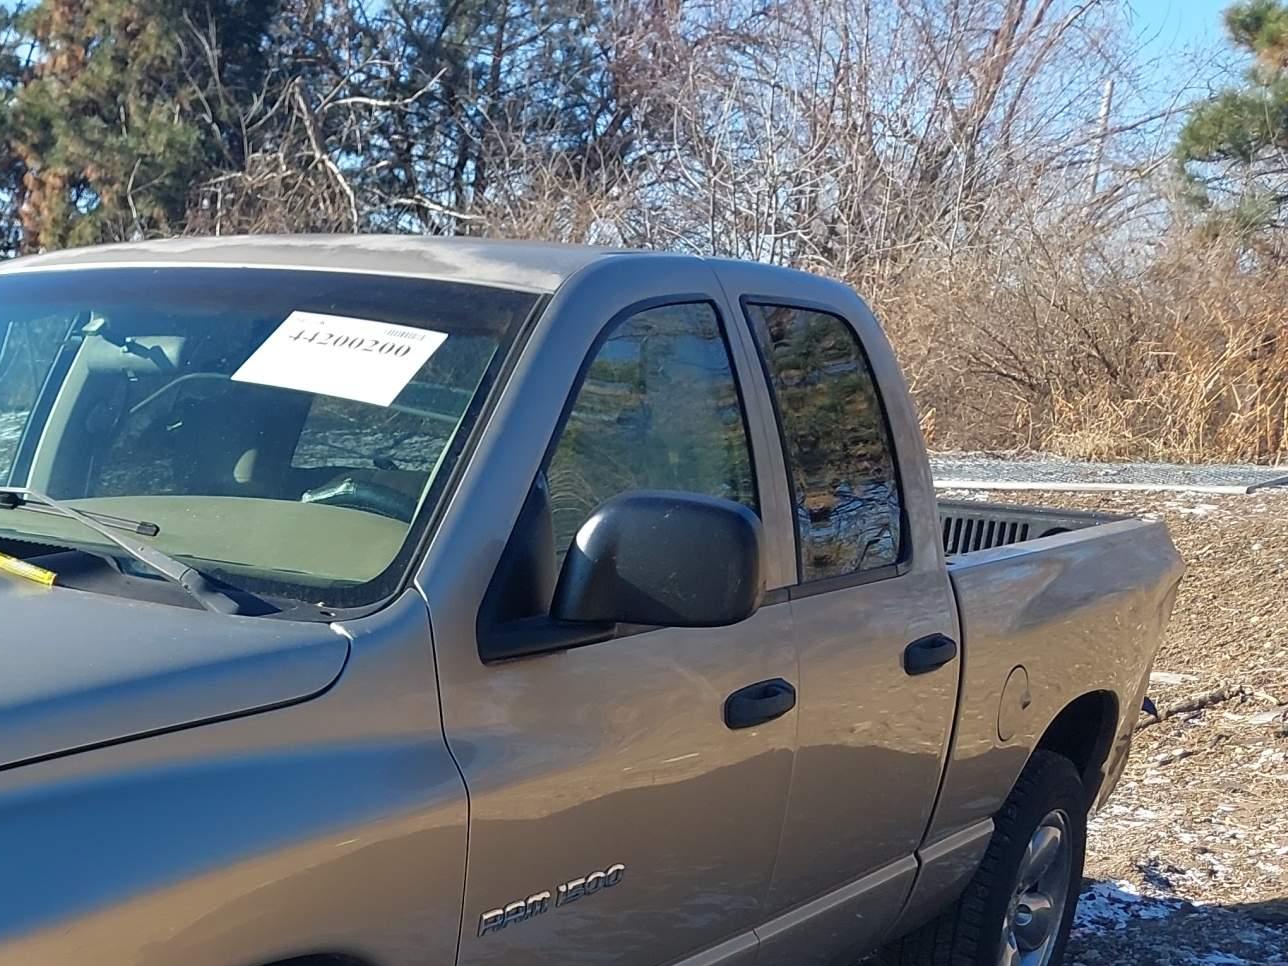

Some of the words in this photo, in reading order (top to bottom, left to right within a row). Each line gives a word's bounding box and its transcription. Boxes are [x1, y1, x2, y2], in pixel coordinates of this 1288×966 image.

[288, 329, 413, 359] 44200200
[477, 890, 551, 937] RAM
[556, 863, 625, 908] 1500
